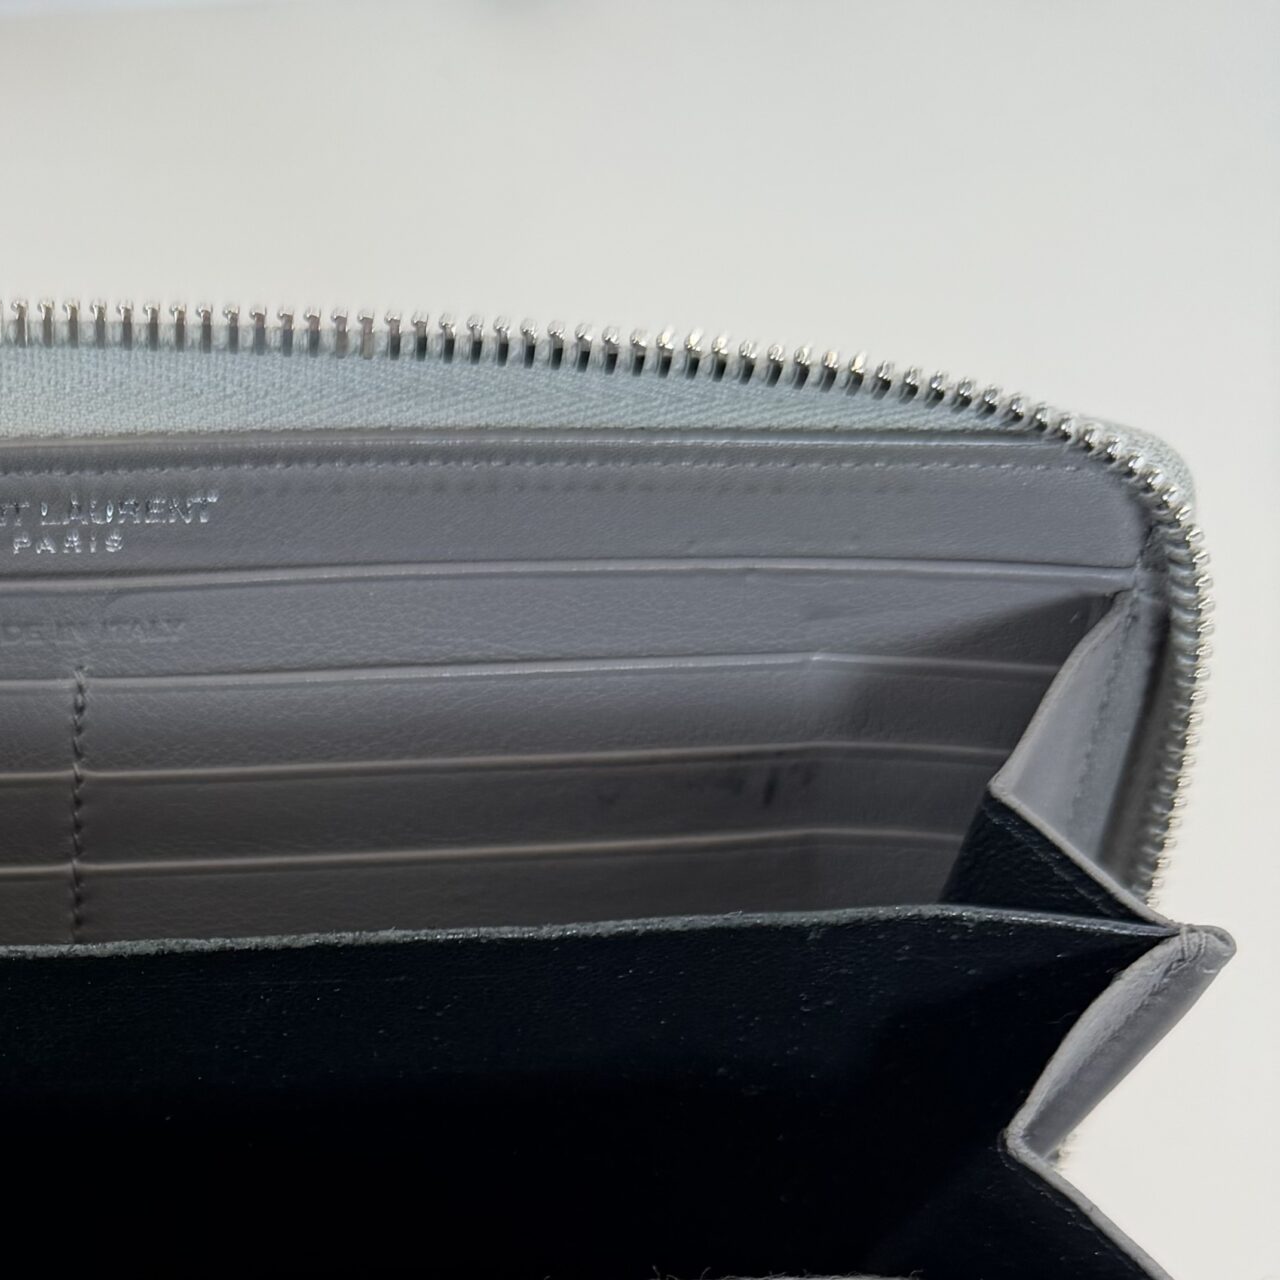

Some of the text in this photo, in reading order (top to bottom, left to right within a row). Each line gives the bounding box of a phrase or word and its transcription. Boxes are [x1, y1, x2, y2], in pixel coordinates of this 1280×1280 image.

[40, 490, 218, 526] LAURENT
[13, 530, 123, 555] PARIS
[53, 618, 87, 647] IN
